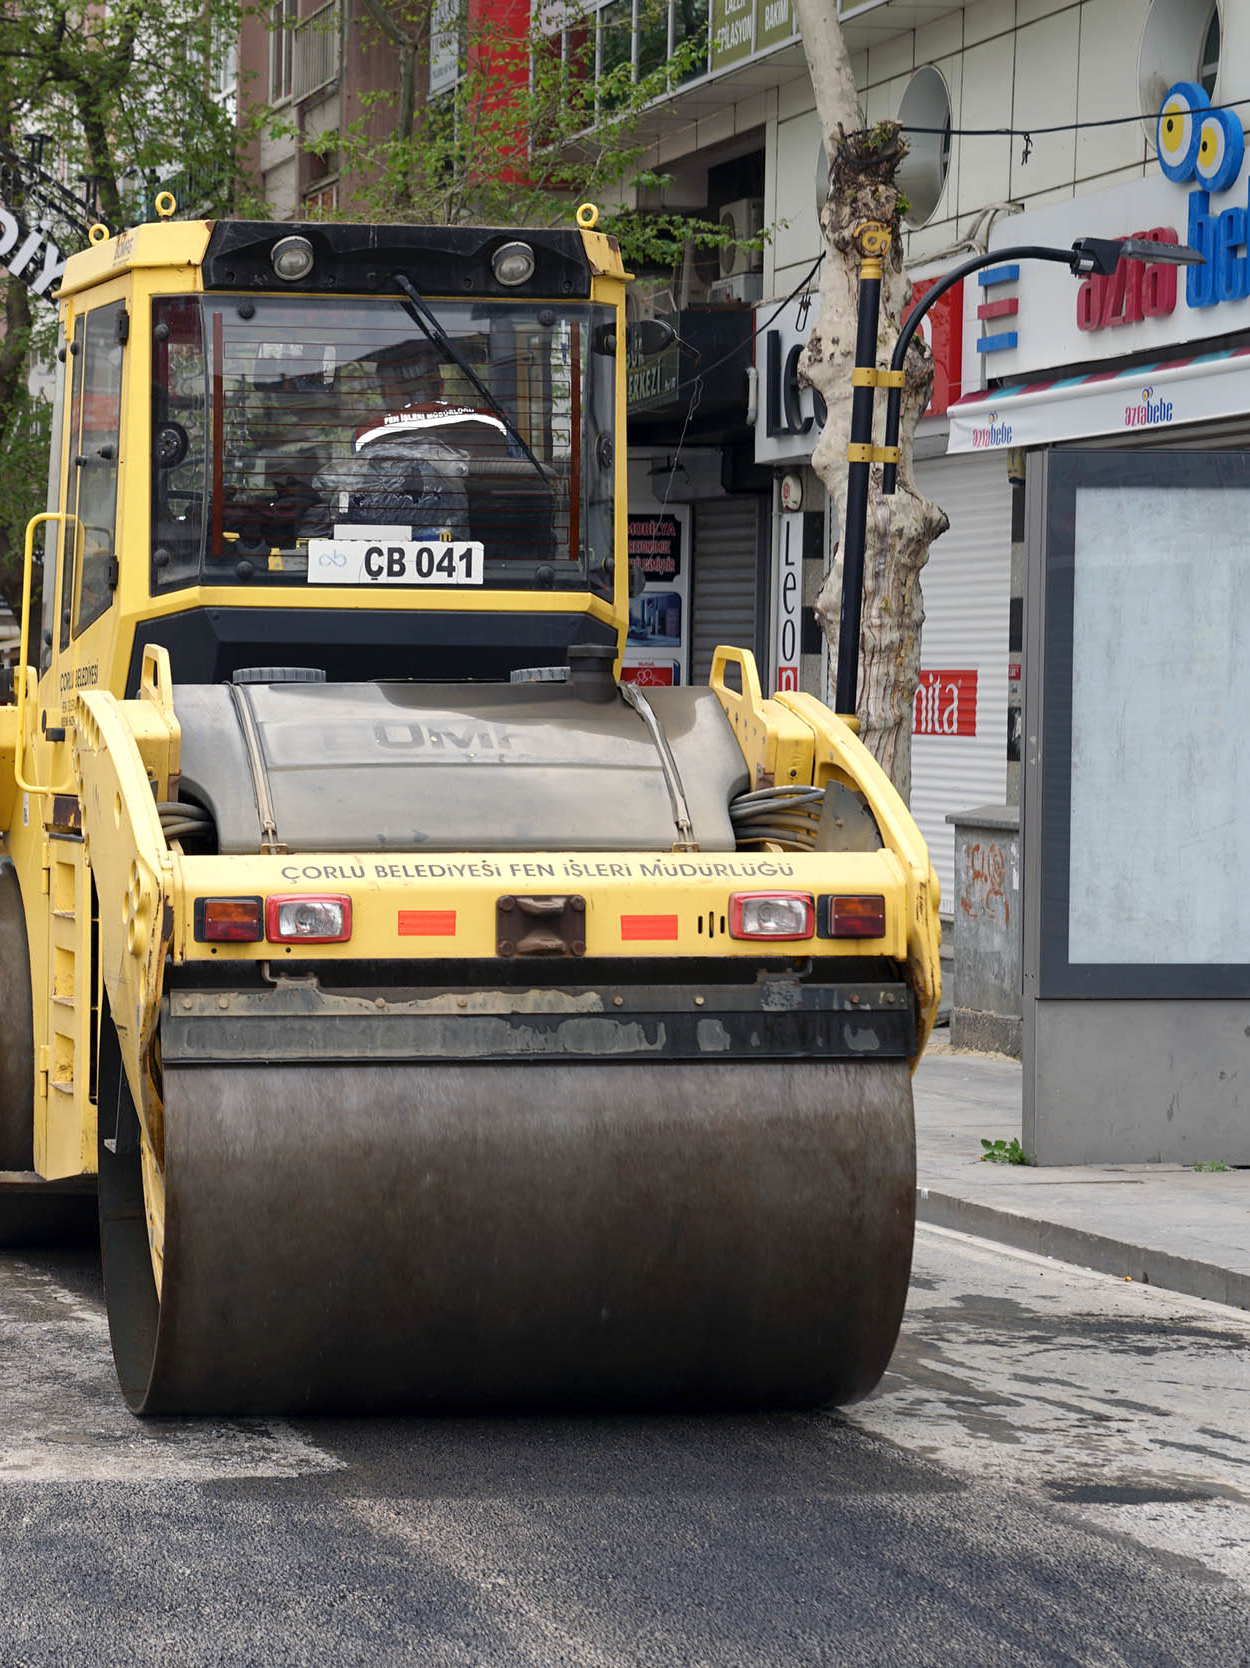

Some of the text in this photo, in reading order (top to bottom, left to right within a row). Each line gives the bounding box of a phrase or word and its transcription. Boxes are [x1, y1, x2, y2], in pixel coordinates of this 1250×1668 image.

[1186, 176, 1250, 308] be
[364, 546, 473, 581] ÇB 041
[281, 861, 794, 884] ÇORLU BELEDİYESİ FEN İŞLERİ MÜDÜRLÜĞÜ
